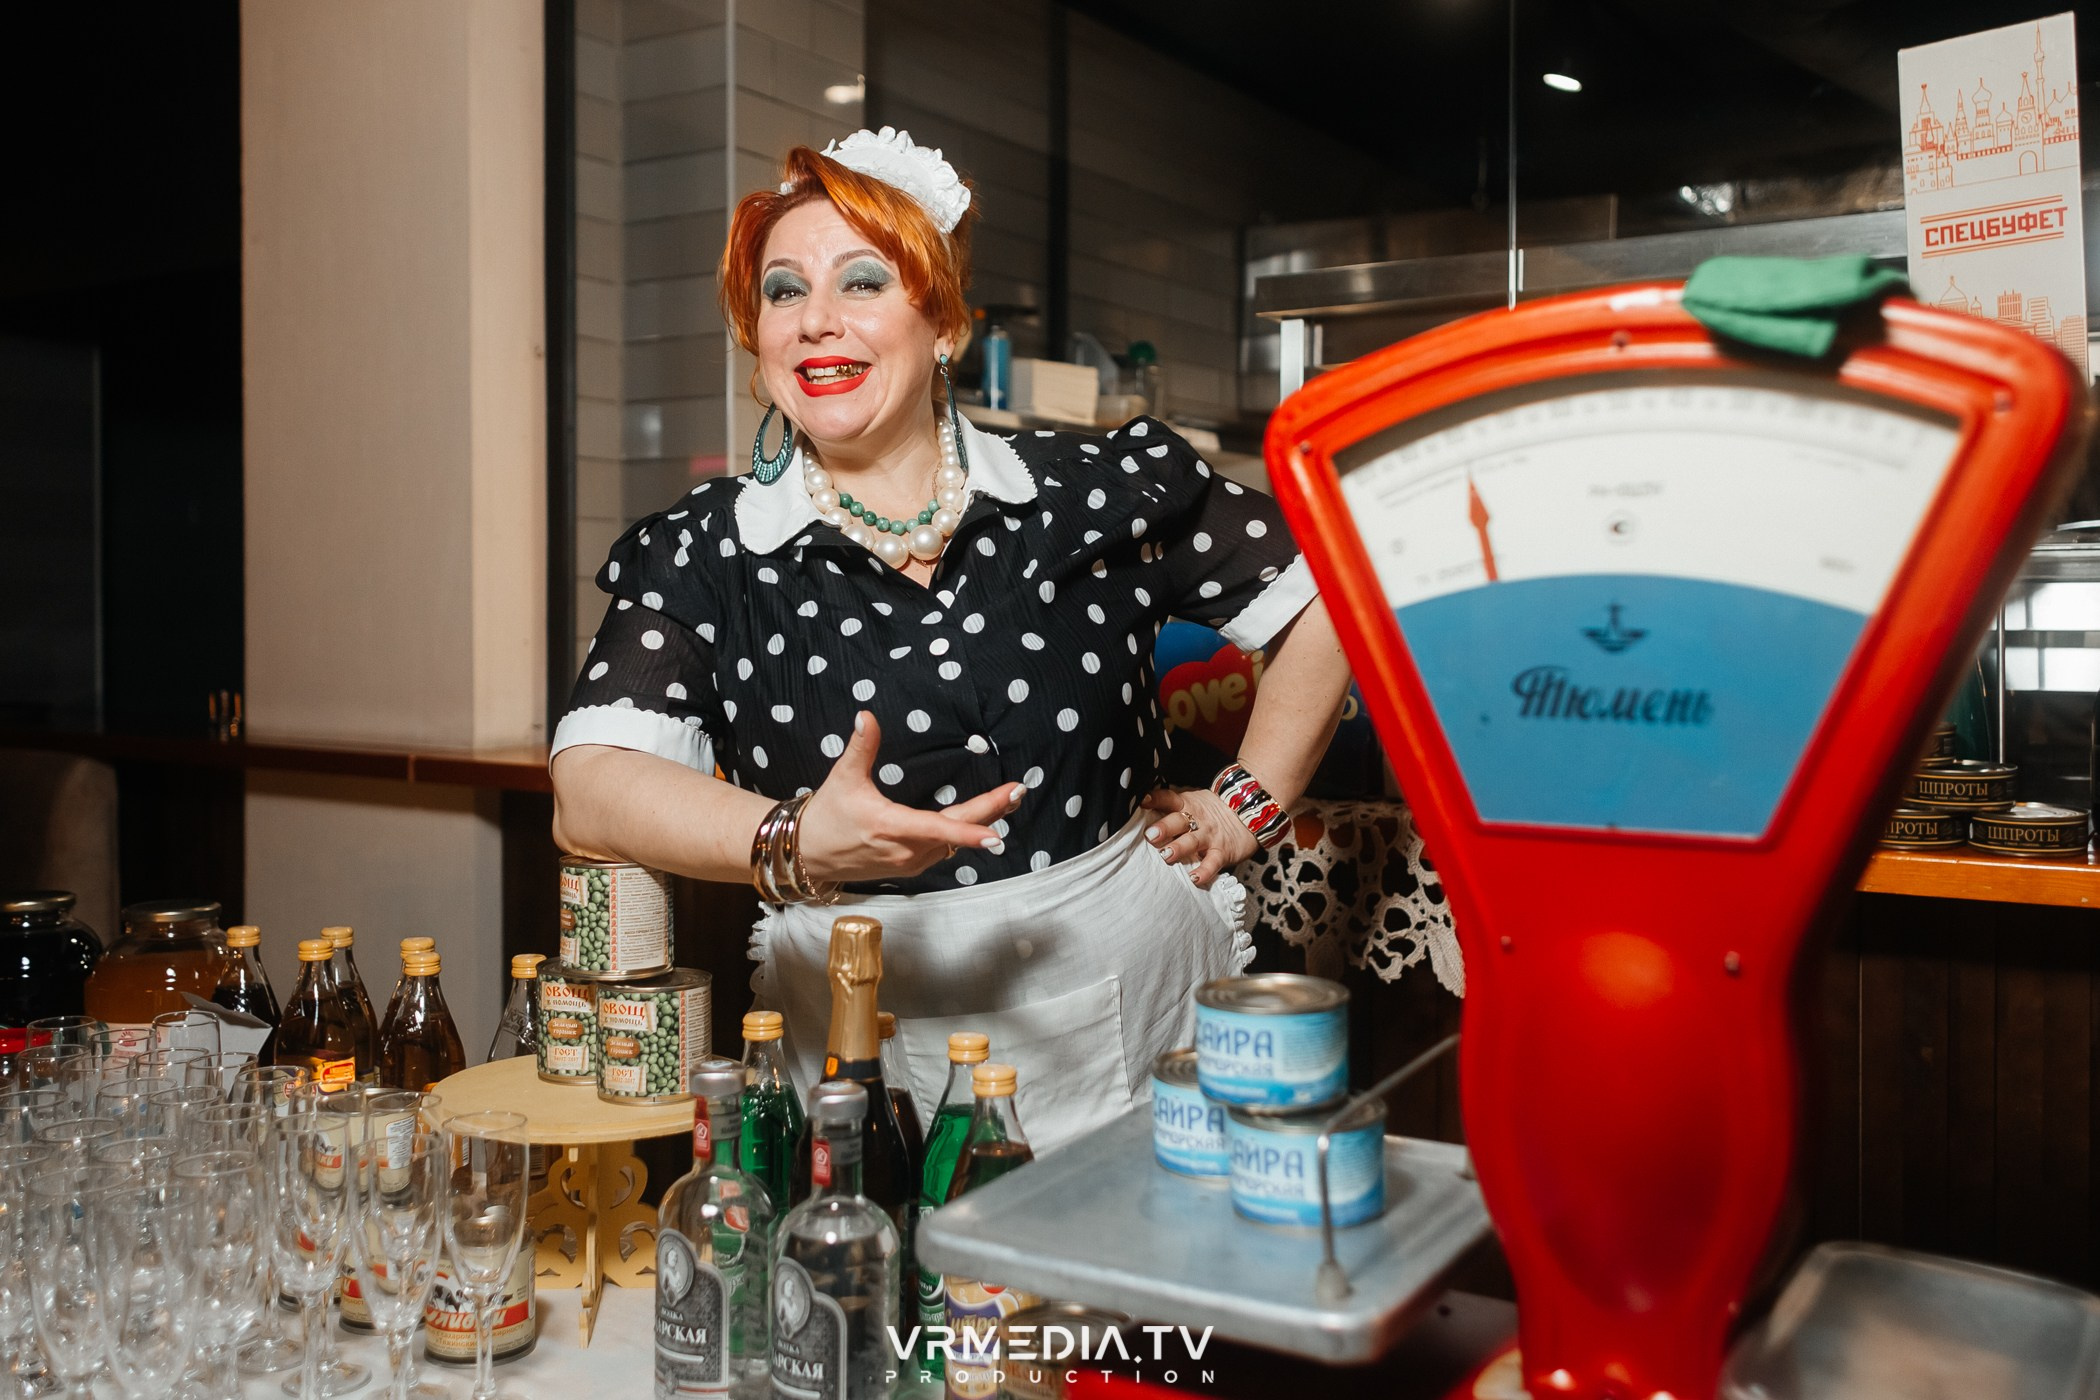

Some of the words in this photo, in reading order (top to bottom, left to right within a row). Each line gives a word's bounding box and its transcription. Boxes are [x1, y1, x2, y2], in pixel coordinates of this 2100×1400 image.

[1925, 206, 2068, 248] СПЕЦБУФЕТ
[1163, 672, 1248, 735] ove
[1919, 780, 1989, 797] ШПРОТЫ
[1886, 821, 1938, 836] РОТЫ
[1988, 825, 2060, 843] ШПРОТЫ
[545, 985, 589, 1001] ОВОЩ
[603, 1002, 646, 1021] ОВОЩ
[554, 1047, 578, 1057] ГОСТ
[612, 1067, 635, 1077] ГОСТ
[1232, 1139, 1304, 1178] АЙРА
[657, 1315, 707, 1345] АРСКАЯ
[773, 1348, 824, 1379] АРСКАЯ
